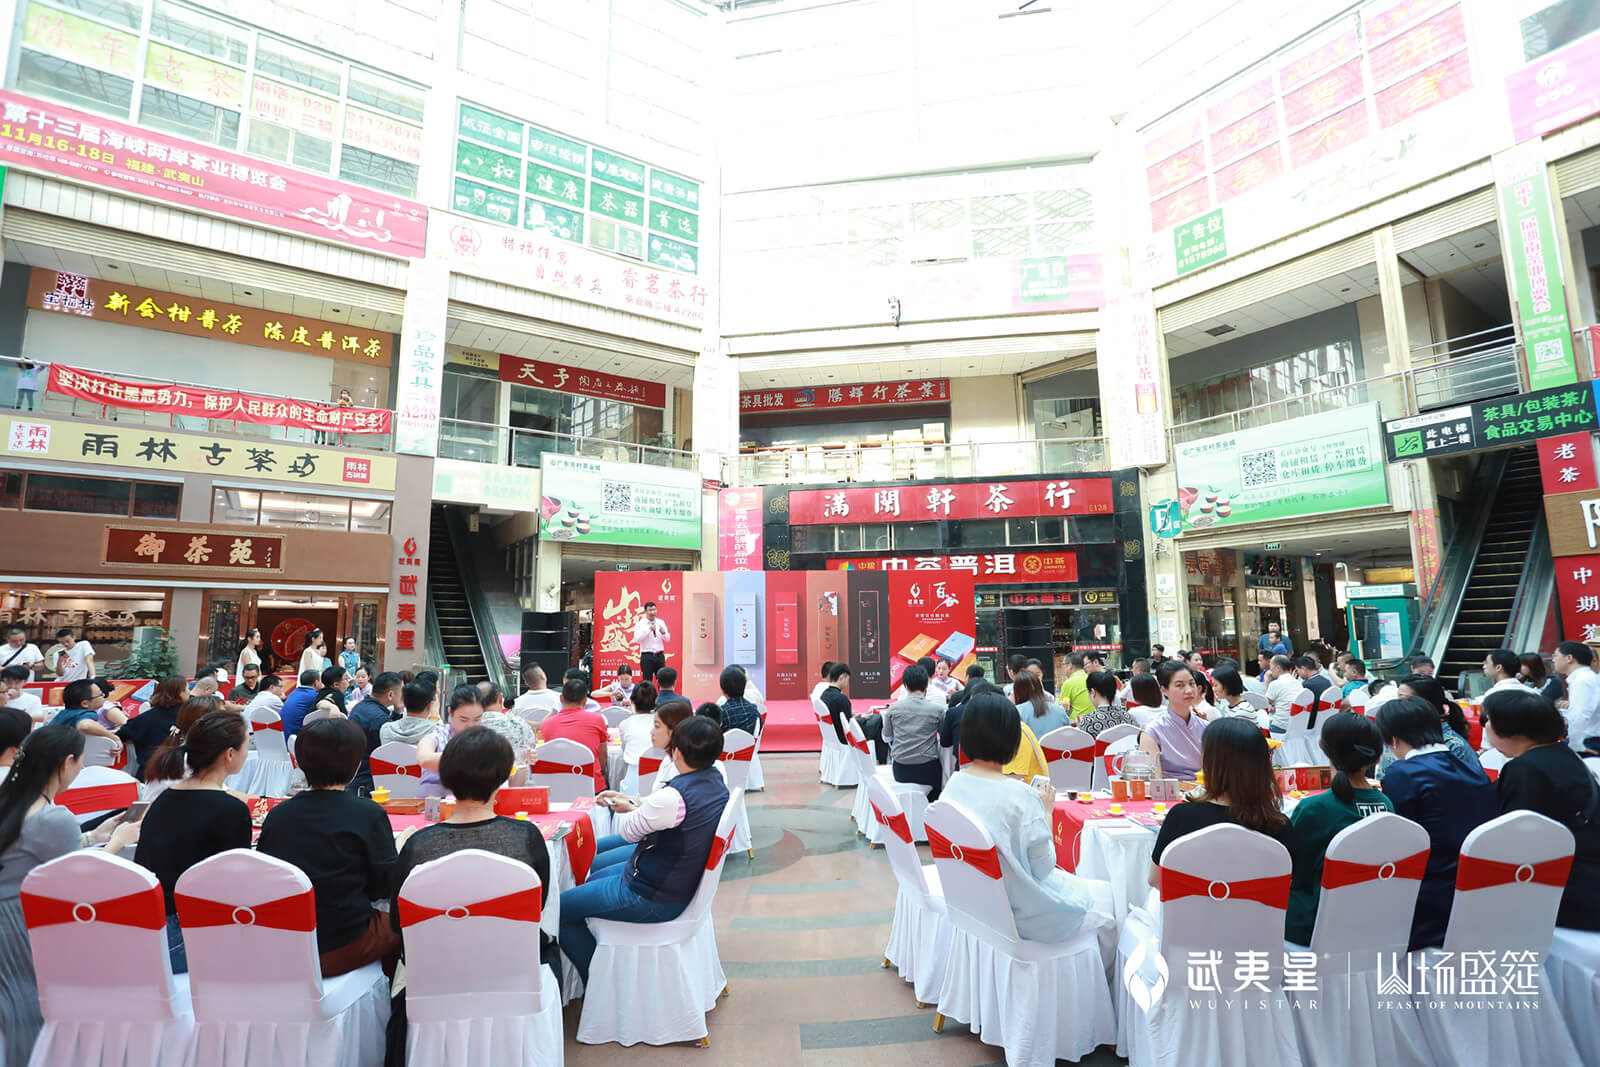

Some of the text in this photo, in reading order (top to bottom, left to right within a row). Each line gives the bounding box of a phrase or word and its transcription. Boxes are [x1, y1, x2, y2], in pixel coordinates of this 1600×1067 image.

[1, 124, 115, 165] 11月16-18日
[3, 103, 288, 192] 第十三届海峡两岸茶业博览会
[1177, 216, 1223, 248] 广告位
[104, 291, 383, 359] 新会柑普茶 陈皮普洱茶
[410, 329, 438, 390] 珍品茶具
[743, 392, 784, 408] 茶具批发
[1482, 390, 1588, 421] 茶具/包装茶/
[25, 425, 47, 452] 雨林
[1426, 423, 1467, 439] 此电梯
[1483, 409, 1594, 440] 食品交易中心
[82, 432, 320, 478] 雨林古茶坊
[1426, 434, 1471, 450] 直上二楼
[345, 461, 369, 471] 雨林
[1552, 442, 1580, 483] 老茶
[135, 531, 257, 566] 御茶苑
